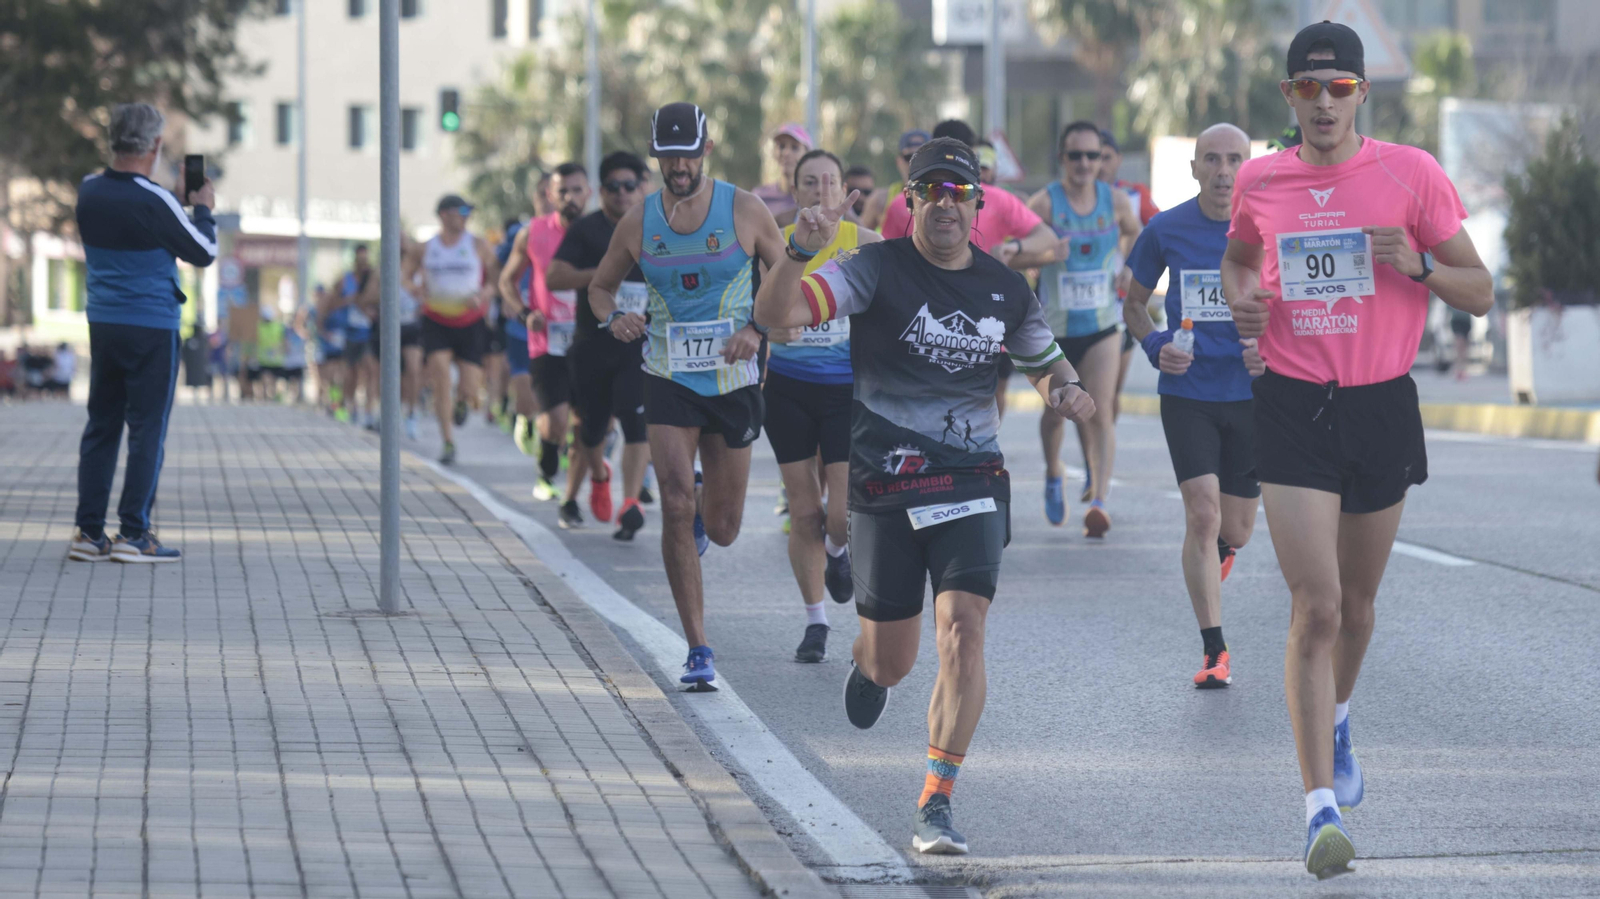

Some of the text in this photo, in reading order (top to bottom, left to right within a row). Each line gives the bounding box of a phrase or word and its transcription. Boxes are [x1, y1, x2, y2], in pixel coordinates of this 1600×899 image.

[1299, 211, 1346, 220] CUPRA
[1304, 219, 1341, 228] TURIAL
[1303, 238, 1341, 249] MARATÓN
[1305, 252, 1335, 280] 90
[1304, 284, 1346, 296] EVOS
[1301, 308, 1327, 317] MEDIA
[1292, 313, 1358, 330] MARATÓN
[1294, 329, 1315, 337] CIUDAD
[1325, 327, 1358, 335] ALGECIRAS
[682, 337, 714, 357] 177
[914, 346, 990, 363] TRAIL
[685, 360, 716, 369] EVOS
[928, 358, 975, 369] RUNNING
[887, 474, 954, 494] RECAMBIO
[931, 505, 971, 521] EVOS
